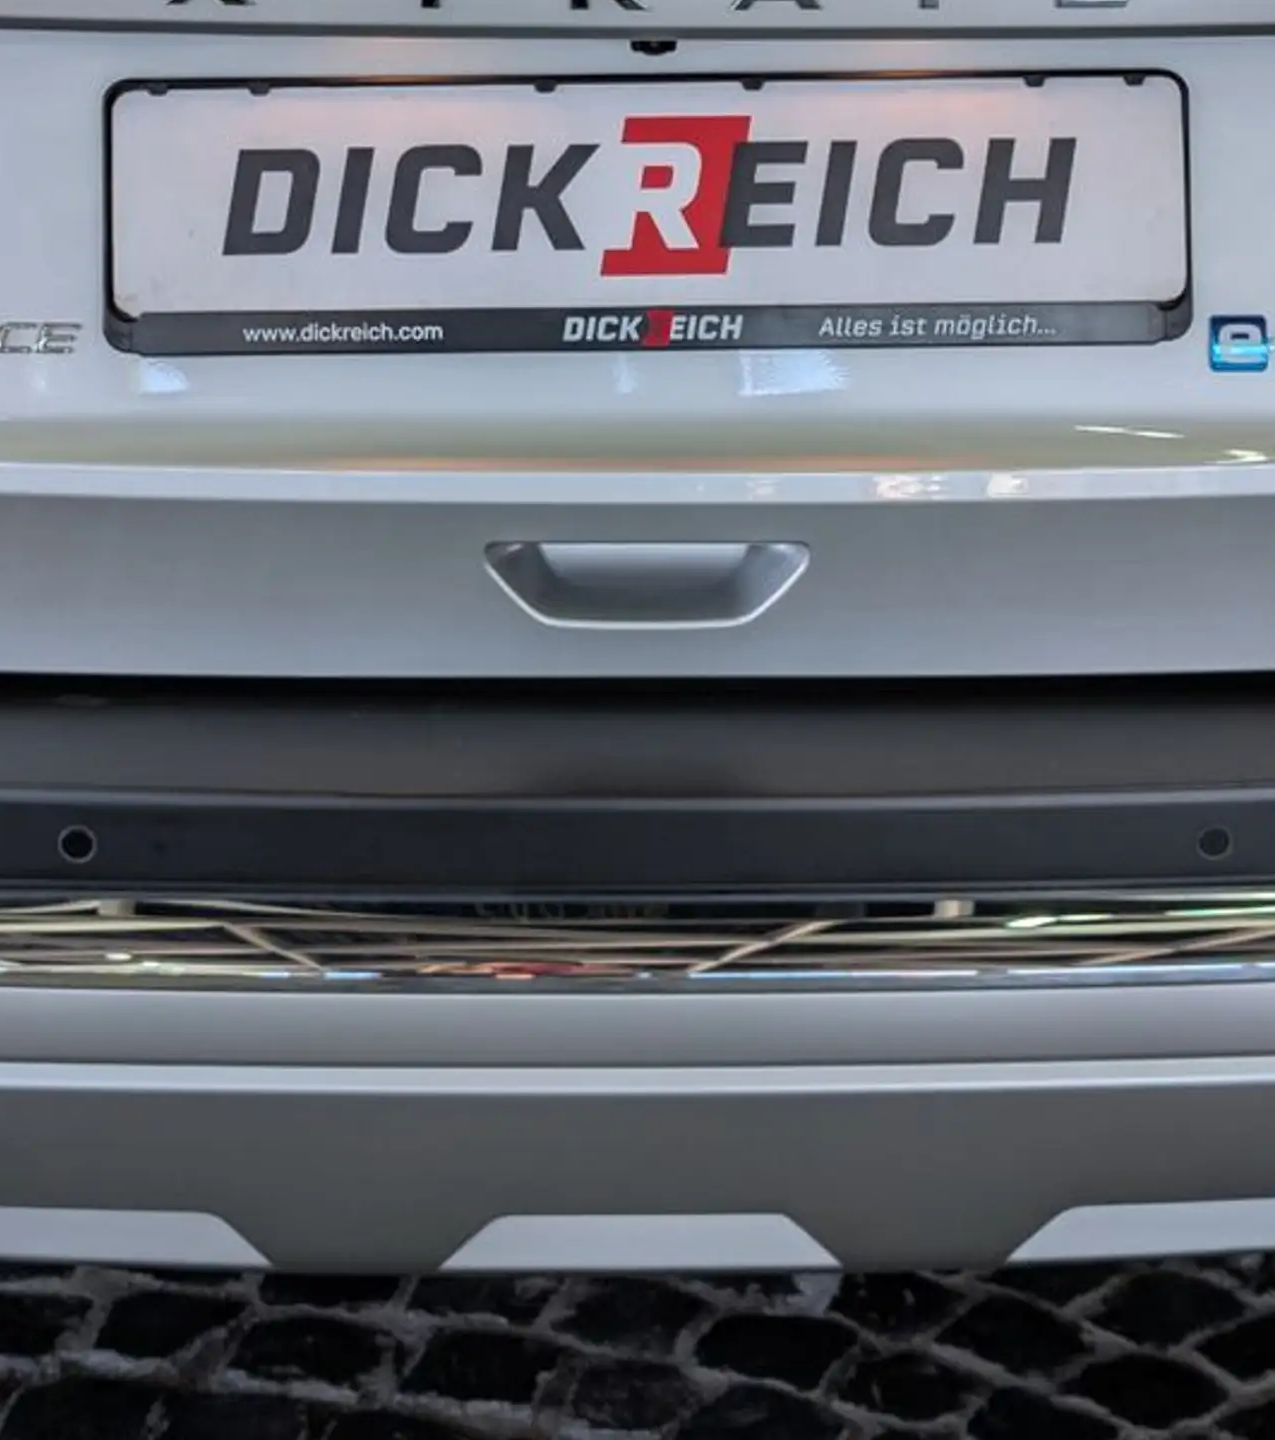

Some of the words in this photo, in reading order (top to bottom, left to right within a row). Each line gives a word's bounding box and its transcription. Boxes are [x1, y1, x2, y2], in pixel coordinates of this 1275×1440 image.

[222, 136, 1078, 256] DICKREICH
[242, 321, 444, 343] www.dickreich.com
[562, 315, 744, 342] DICKEICH
[818, 316, 882, 338] Alles
[889, 314, 927, 336] ist
[933, 312, 1057, 340] möglich...
